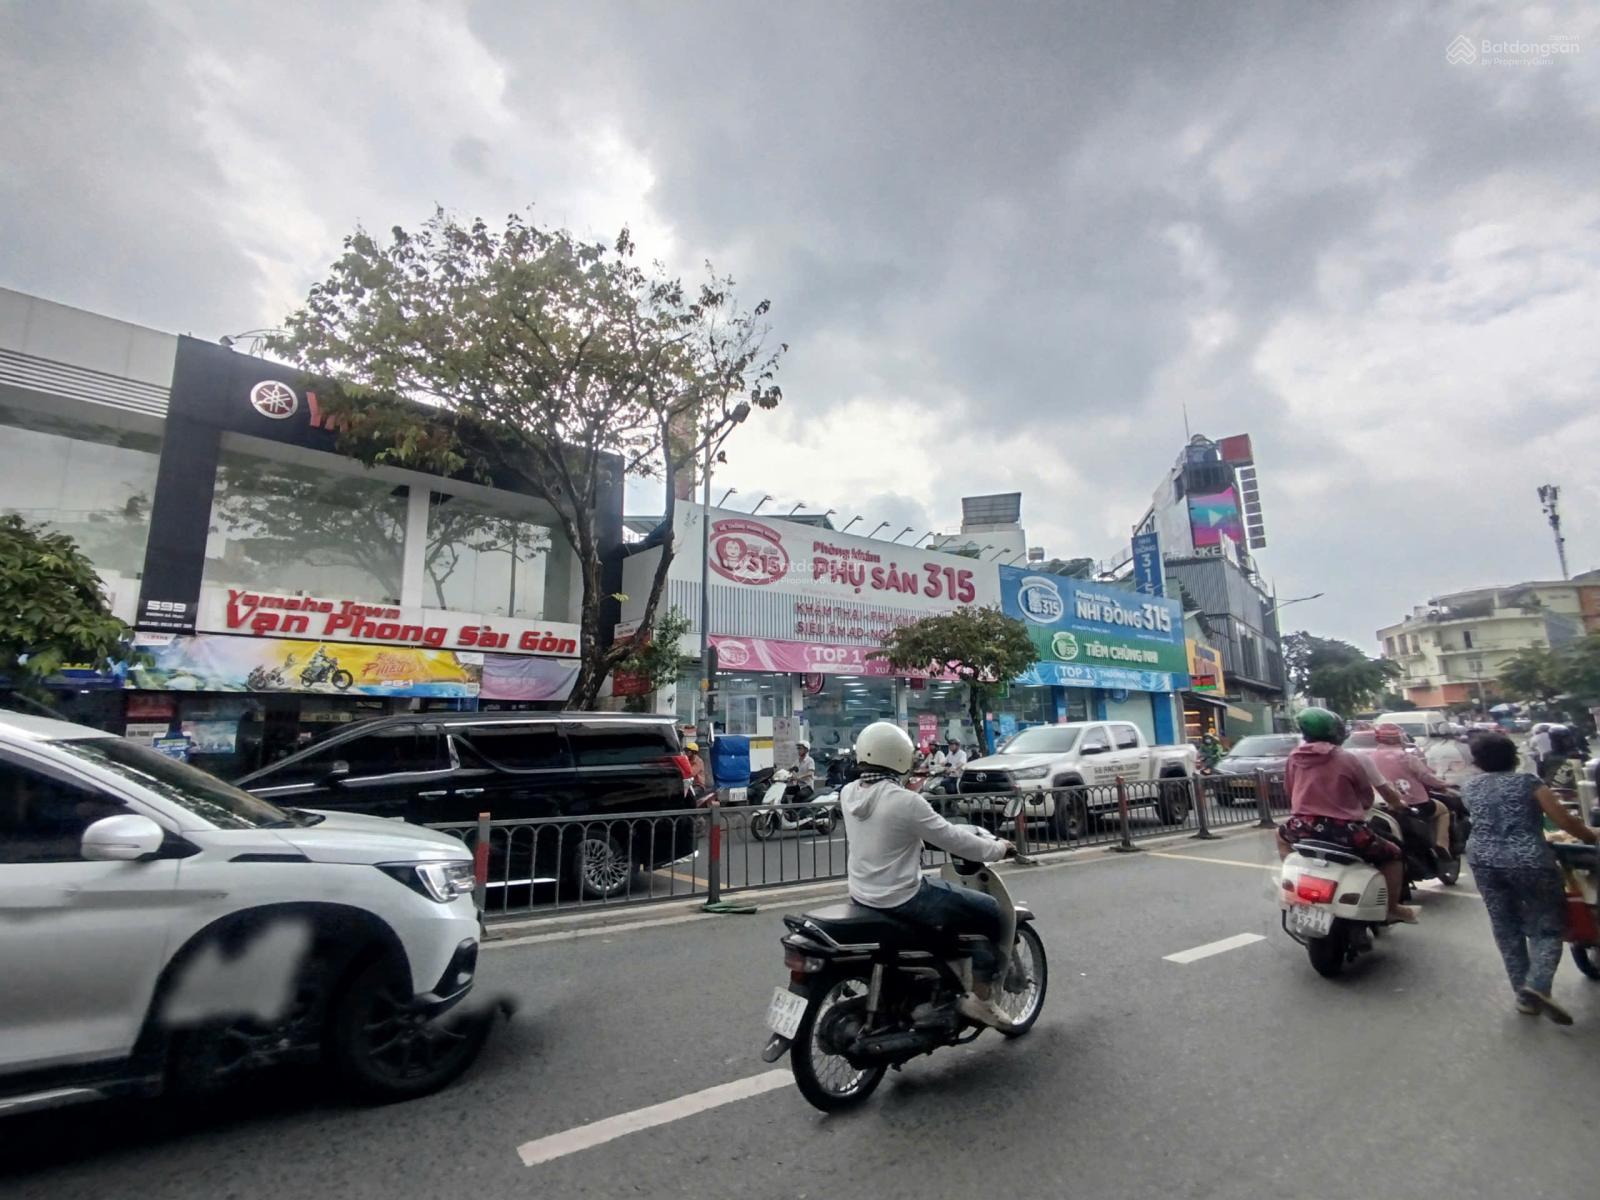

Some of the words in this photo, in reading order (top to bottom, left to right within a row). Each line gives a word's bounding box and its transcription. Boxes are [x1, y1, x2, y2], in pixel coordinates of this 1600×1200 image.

[813, 557, 865, 594] PHỤ
[871, 562, 918, 595] SẢN
[923, 563, 976, 603] 315
[227, 589, 334, 613] Yamaha
[341, 600, 401, 619] Town
[1041, 600, 1060, 617] 315
[1077, 601, 1101, 621] NHI
[1103, 599, 1142, 629] ĐỒNG
[1142, 603, 1171, 633] 315
[226, 603, 310, 636] Vạn
[323, 613, 448, 649] Phong
[519, 631, 577, 654] Gòn
[816, 647, 846, 663] TOP
[852, 650, 861, 664] 1
[1060, 665, 1083, 678] TOP
